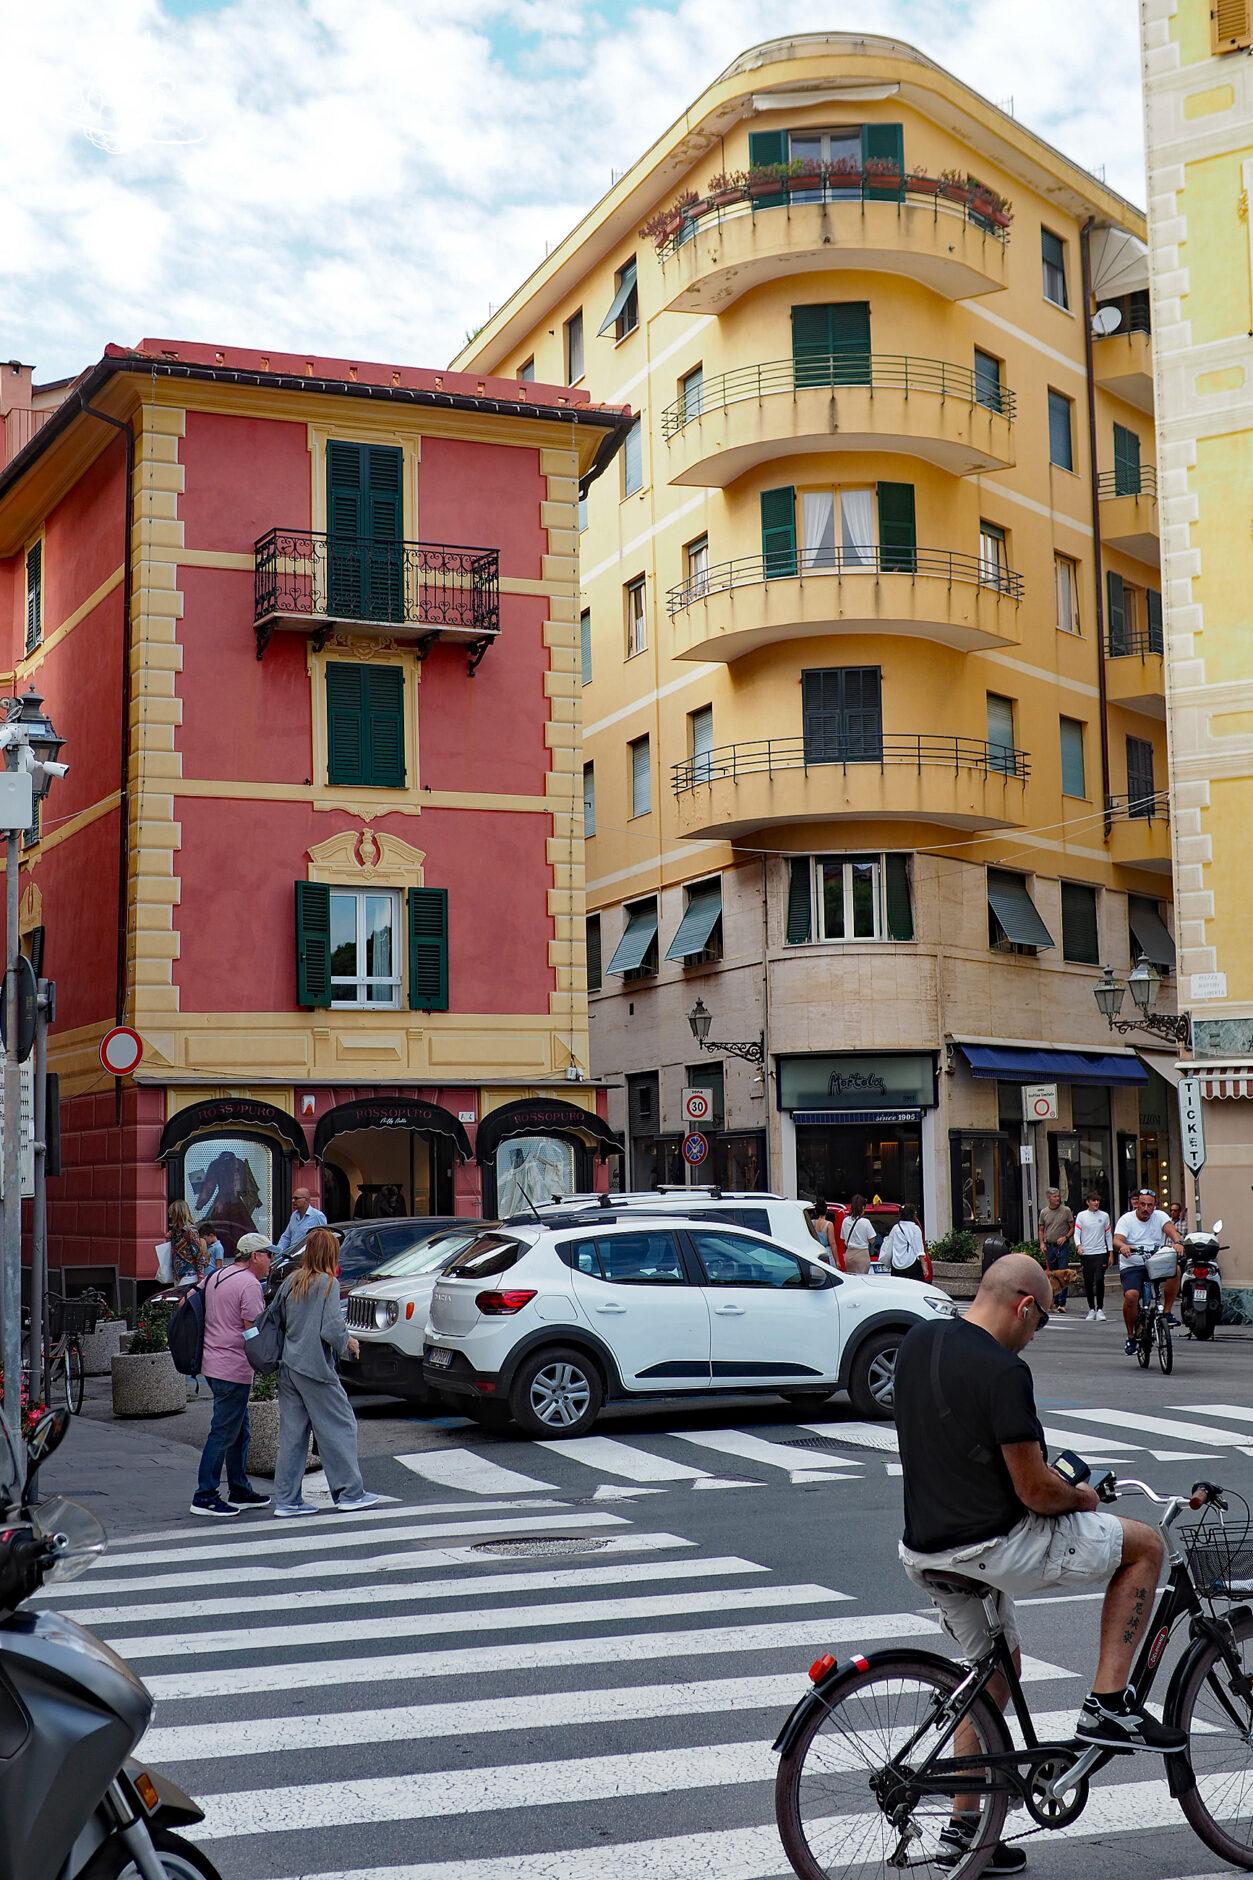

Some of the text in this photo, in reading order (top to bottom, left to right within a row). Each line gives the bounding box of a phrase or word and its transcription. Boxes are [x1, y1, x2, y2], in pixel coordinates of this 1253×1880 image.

[691, 1101, 704, 1113] 30
[356, 1108, 433, 1120] ROSSOPURO
[512, 1111, 586, 1124] ROSSOPURO
[875, 1114, 897, 1122] since
[1184, 1082, 1199, 1162] TICKET
